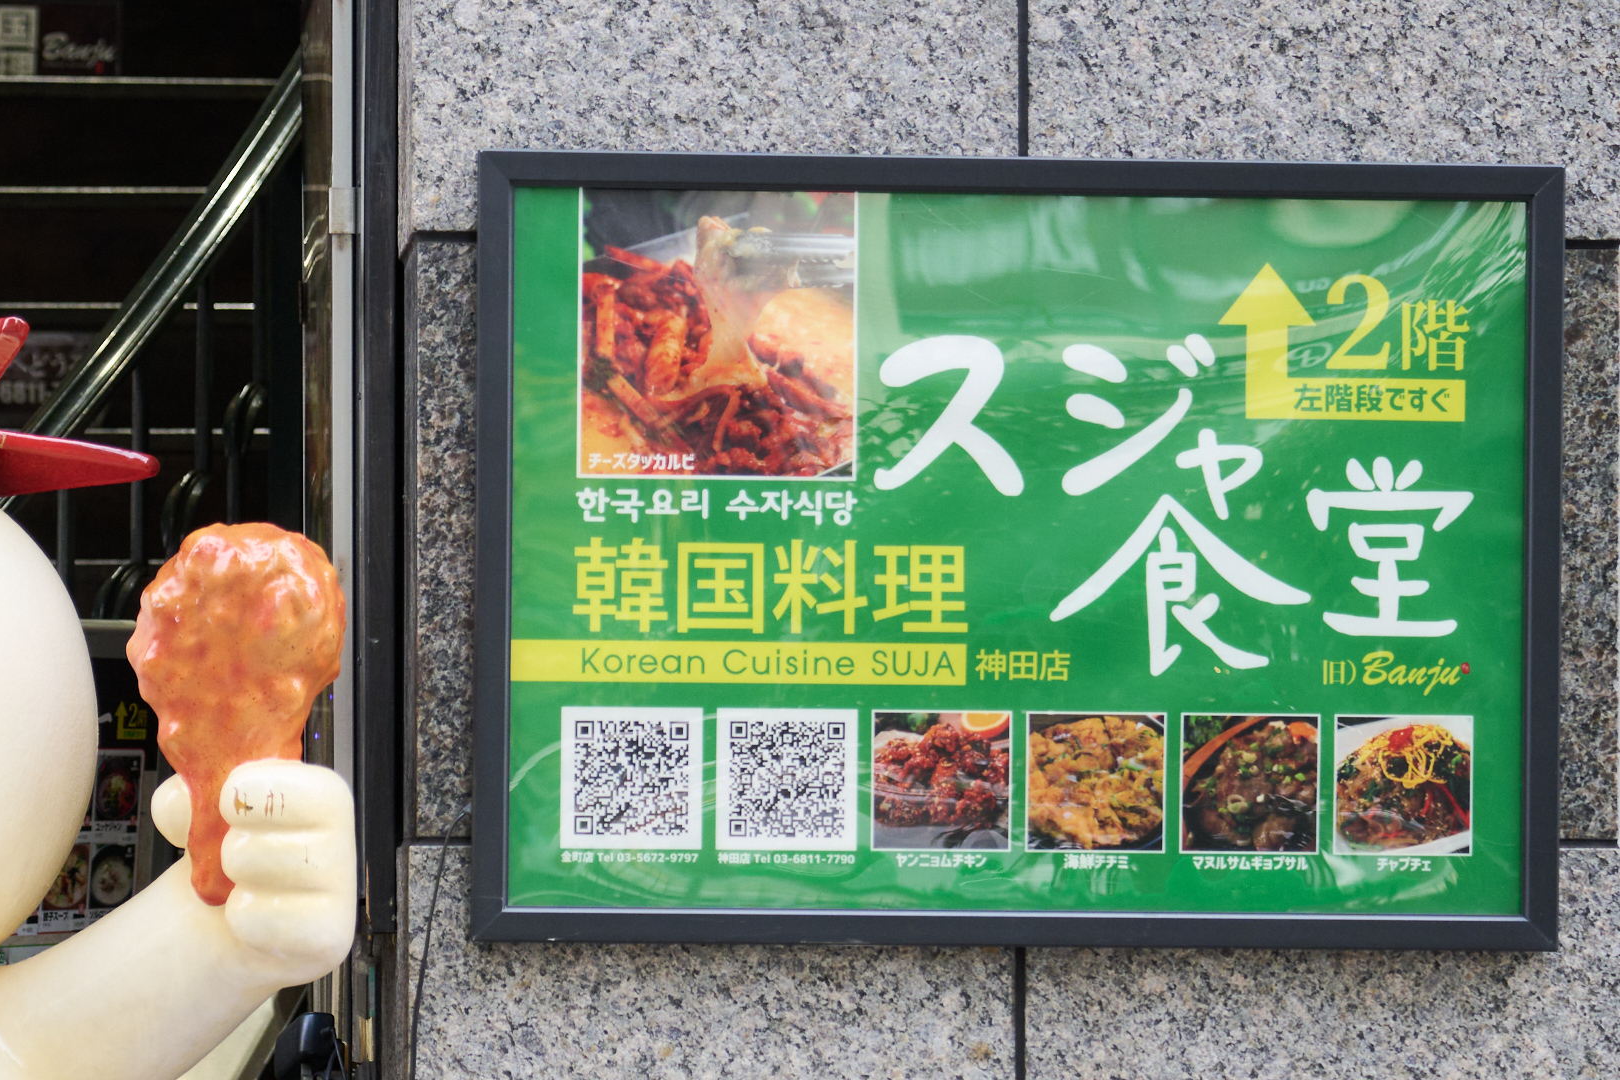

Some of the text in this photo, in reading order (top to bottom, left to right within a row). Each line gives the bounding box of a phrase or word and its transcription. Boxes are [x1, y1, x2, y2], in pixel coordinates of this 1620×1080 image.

[1325, 273, 1470, 372] 2階
[1293, 383, 1451, 414] 左階段ですぐ
[588, 452, 695, 472] チーズタッカルビ
[576, 487, 858, 526] 한국요리 수자식당
[573, 536, 969, 635] 韓国料理
[581, 646, 956, 678] Korean Cuisine SUJA
[975, 649, 1071, 683] 神田店
[1361, 650, 1461, 697] Banju
[560, 852, 699, 864] 金町店 Tel 03-5672-9797
[717, 852, 856, 865] 神田店 Tel 03-6811-7790
[895, 853, 987, 868] ヤンニョムチキン
